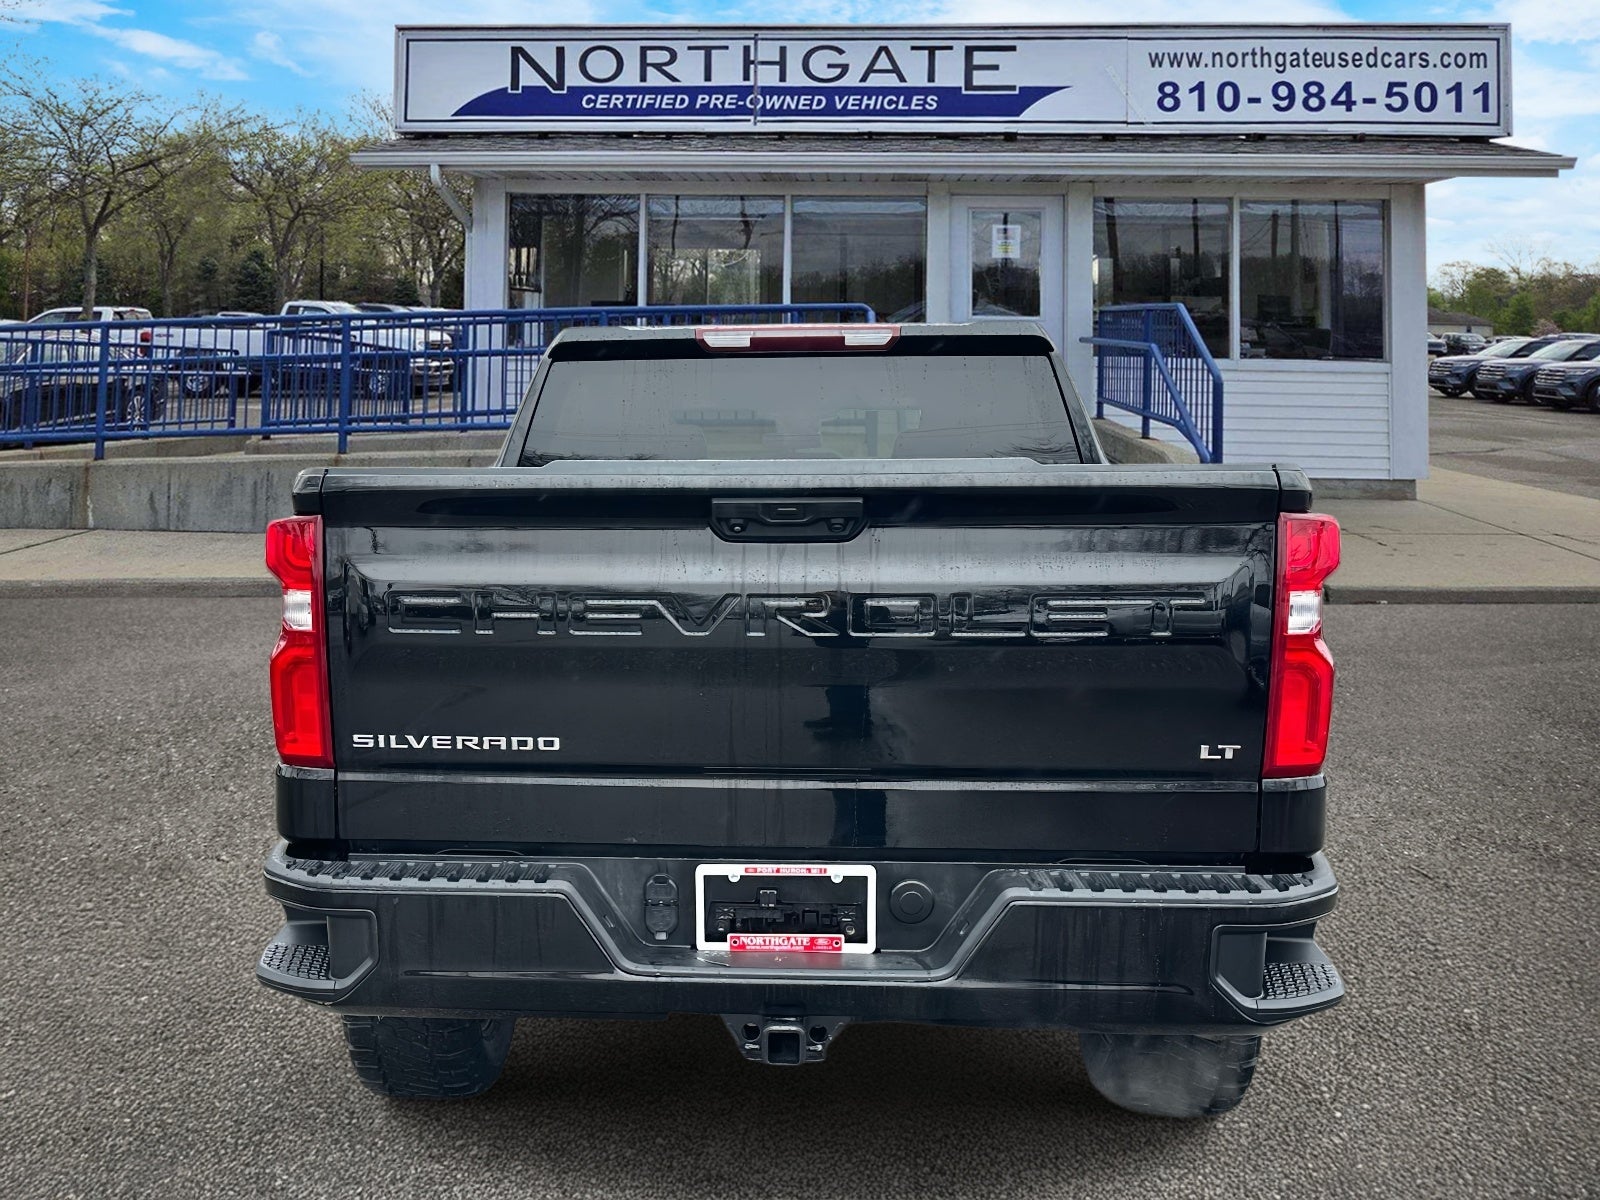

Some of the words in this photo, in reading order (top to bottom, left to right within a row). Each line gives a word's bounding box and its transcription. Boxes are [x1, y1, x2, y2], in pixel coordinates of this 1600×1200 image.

[510, 44, 1017, 92] NORTHGATE
[1148, 45, 1488, 73] www.northgateusedcars.com
[581, 94, 690, 109] CERTIFIED
[695, 94, 827, 110] PRE-OWNED
[834, 95, 939, 110] VEHICLES
[1156, 80, 1491, 114] 810-984-5011
[387, 591, 1207, 638] CHEVROLET
[352, 733, 561, 751] SILVERADO
[1199, 744, 1242, 760] LT
[740, 936, 811, 946] NORTHGATE
